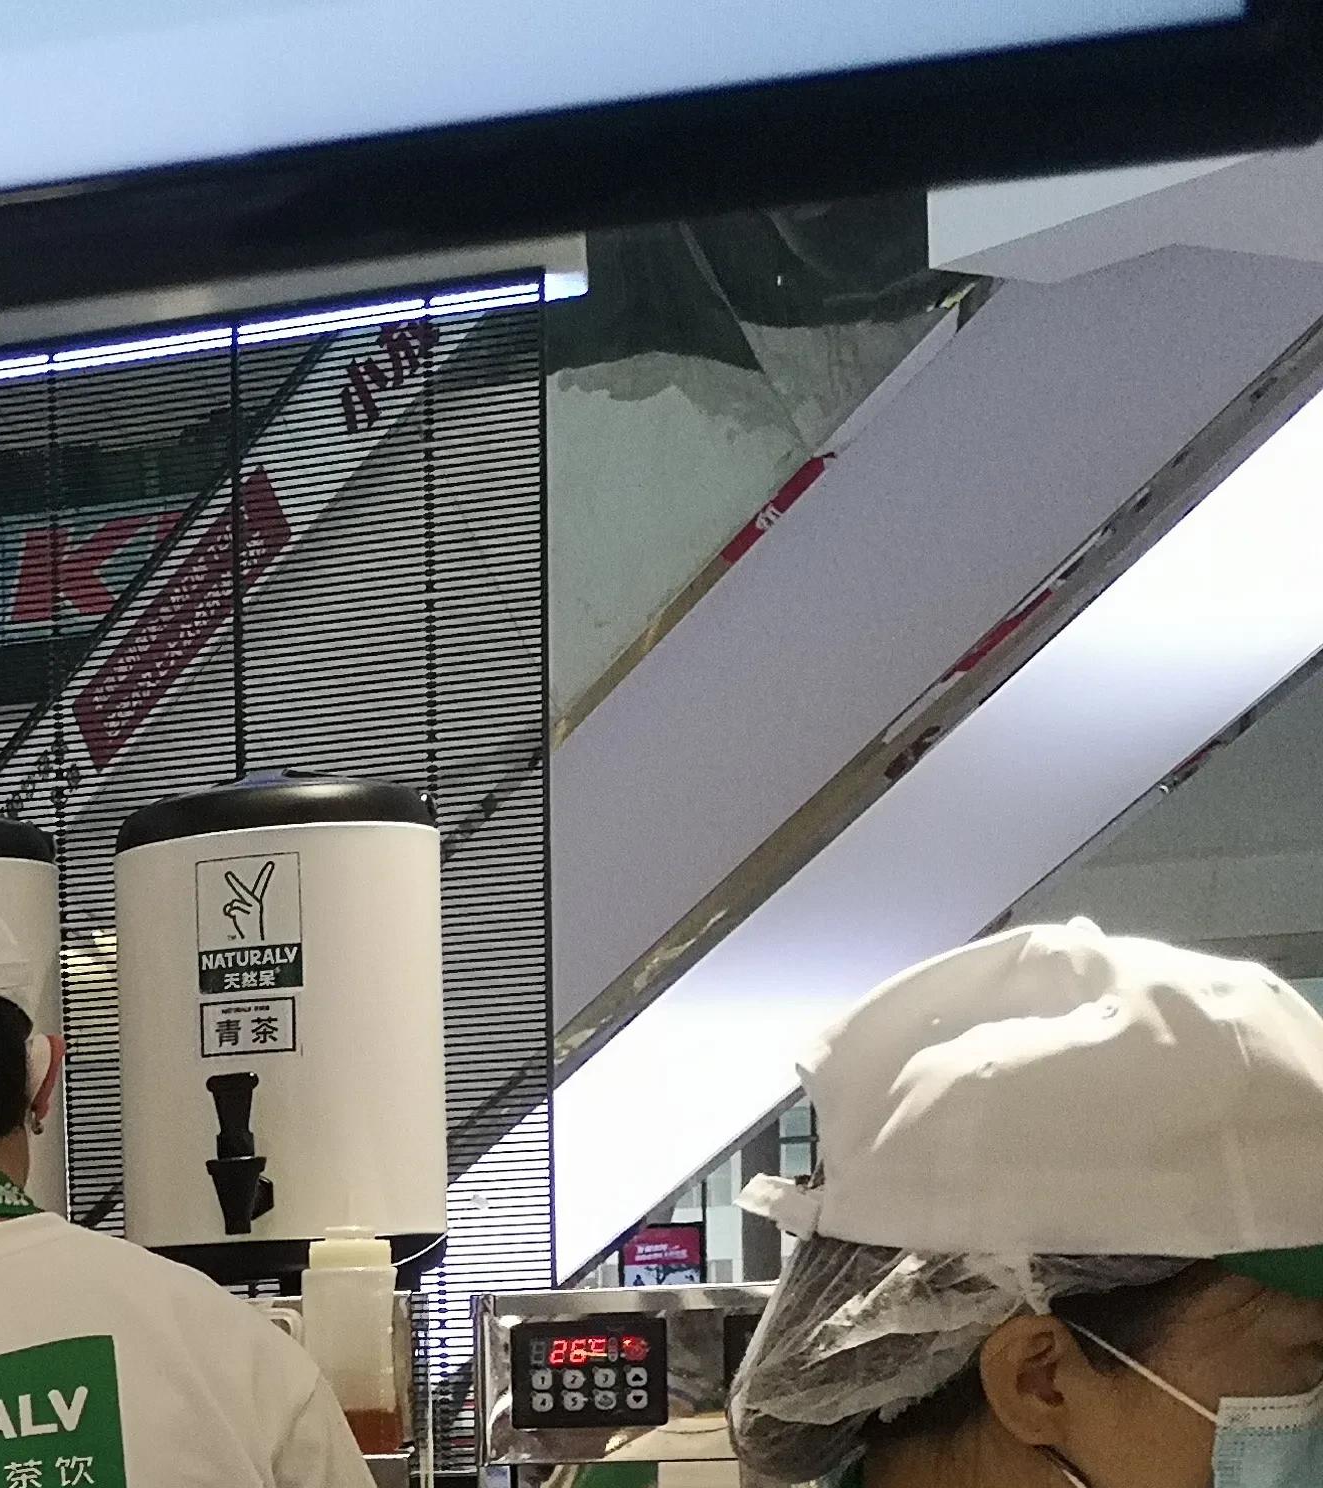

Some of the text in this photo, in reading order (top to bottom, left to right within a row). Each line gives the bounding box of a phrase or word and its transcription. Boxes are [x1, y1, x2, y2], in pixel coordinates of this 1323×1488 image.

[202, 946, 297, 970] NATURALV
[224, 969, 275, 989] 天然呆
[215, 1016, 278, 1047] 青茶
